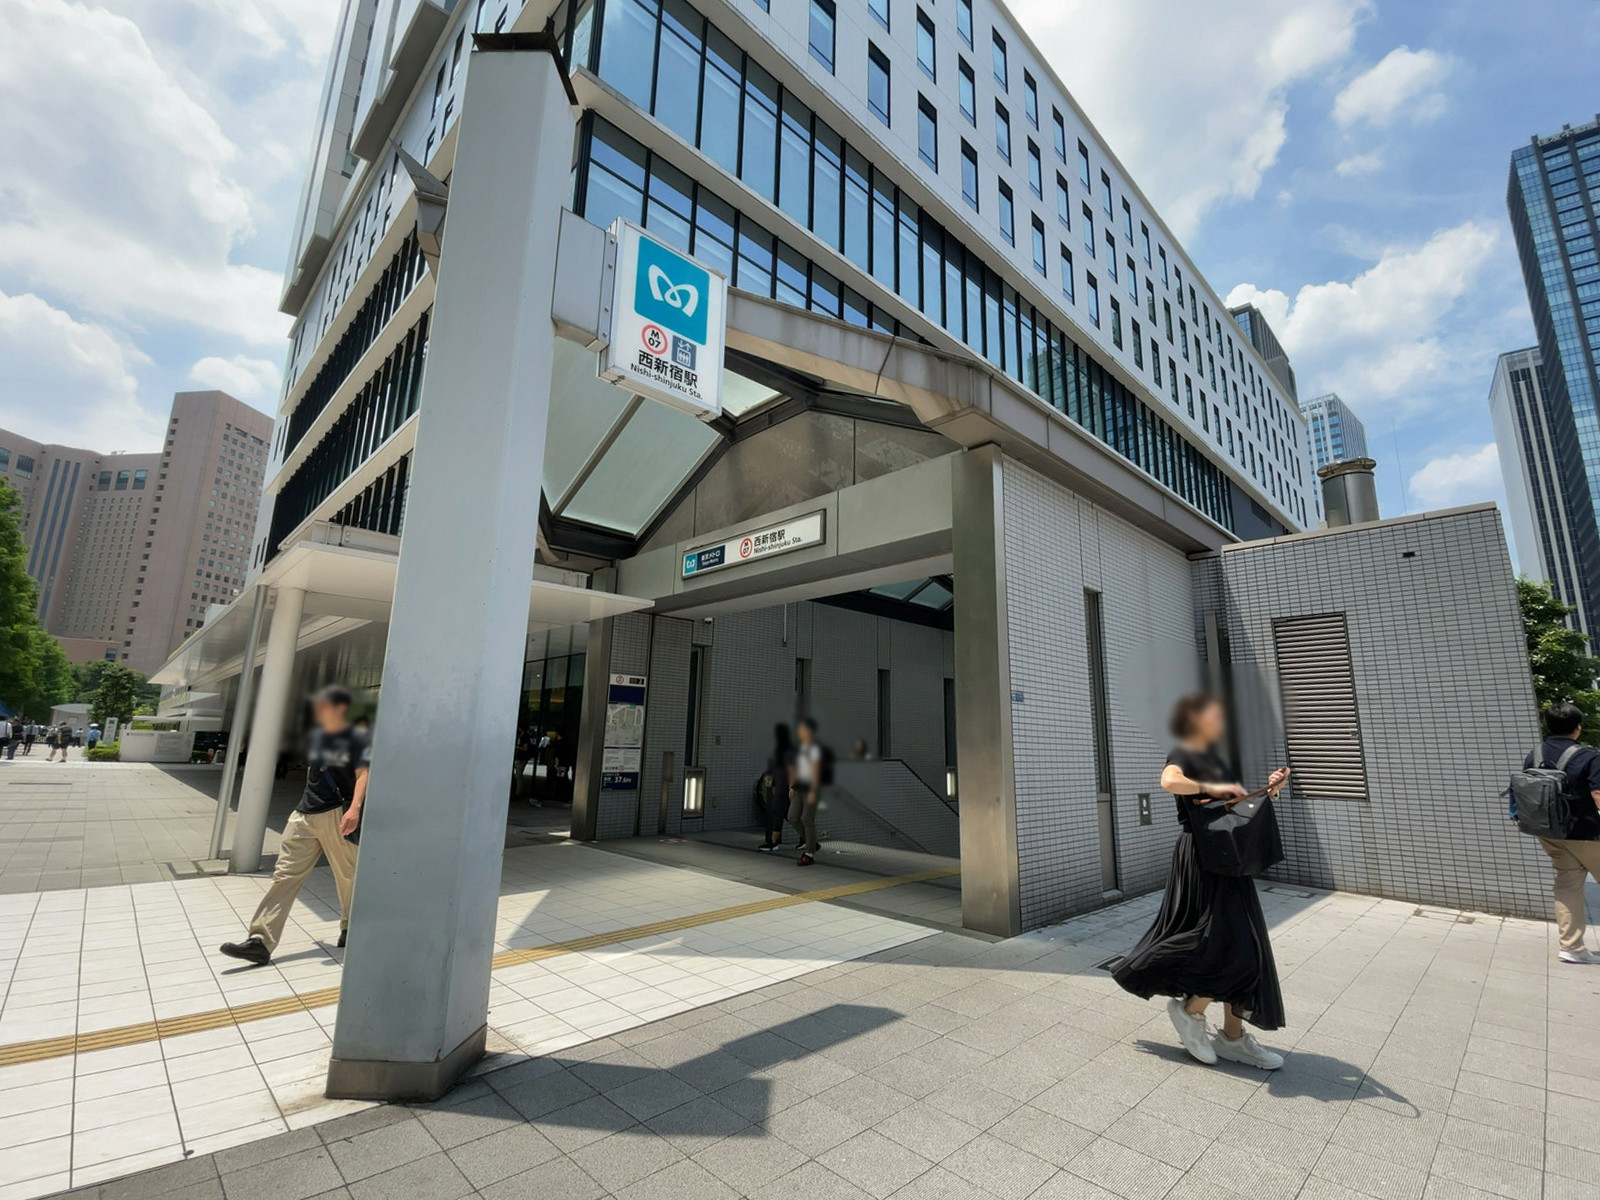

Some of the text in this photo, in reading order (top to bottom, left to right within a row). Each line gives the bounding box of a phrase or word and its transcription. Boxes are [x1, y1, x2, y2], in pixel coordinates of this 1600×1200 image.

[647, 337, 661, 348] 07
[650, 330, 660, 339] M
[638, 349, 698, 389] 西新宿駅
[630, 362, 703, 400] Nishi-shinjuku Sta.
[754, 529, 785, 546] 西新宿駅
[753, 539, 791, 554] Nishi-shinjuku
